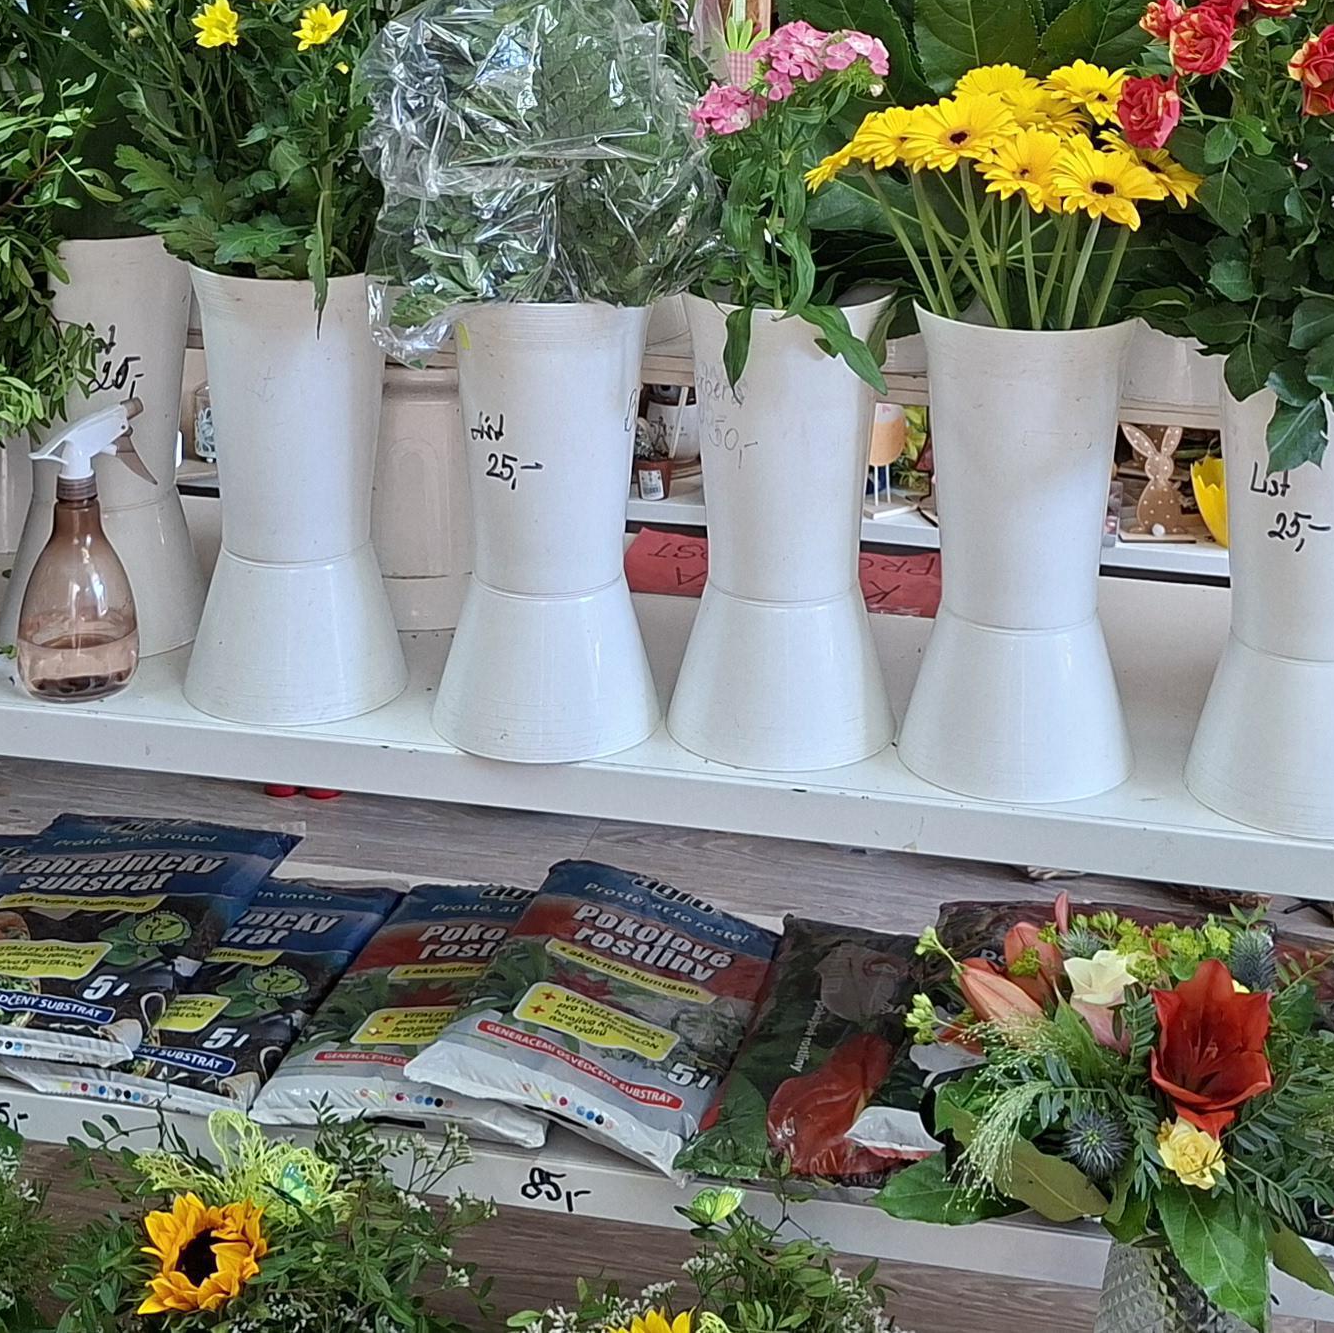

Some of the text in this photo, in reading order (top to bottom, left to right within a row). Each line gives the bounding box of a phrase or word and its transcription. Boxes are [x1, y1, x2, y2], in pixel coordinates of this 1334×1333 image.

[485, 452, 545, 491] 25,-
[1267, 511, 1332, 553] 25,-
[572, 903, 733, 969] Pokojové
[572, 926, 716, 983] rostliny
[41, 997, 103, 1019] SUBSTRÁT
[160, 1048, 223, 1070] SUBSTRÁT
[521, 1167, 592, 1212] 85,-
